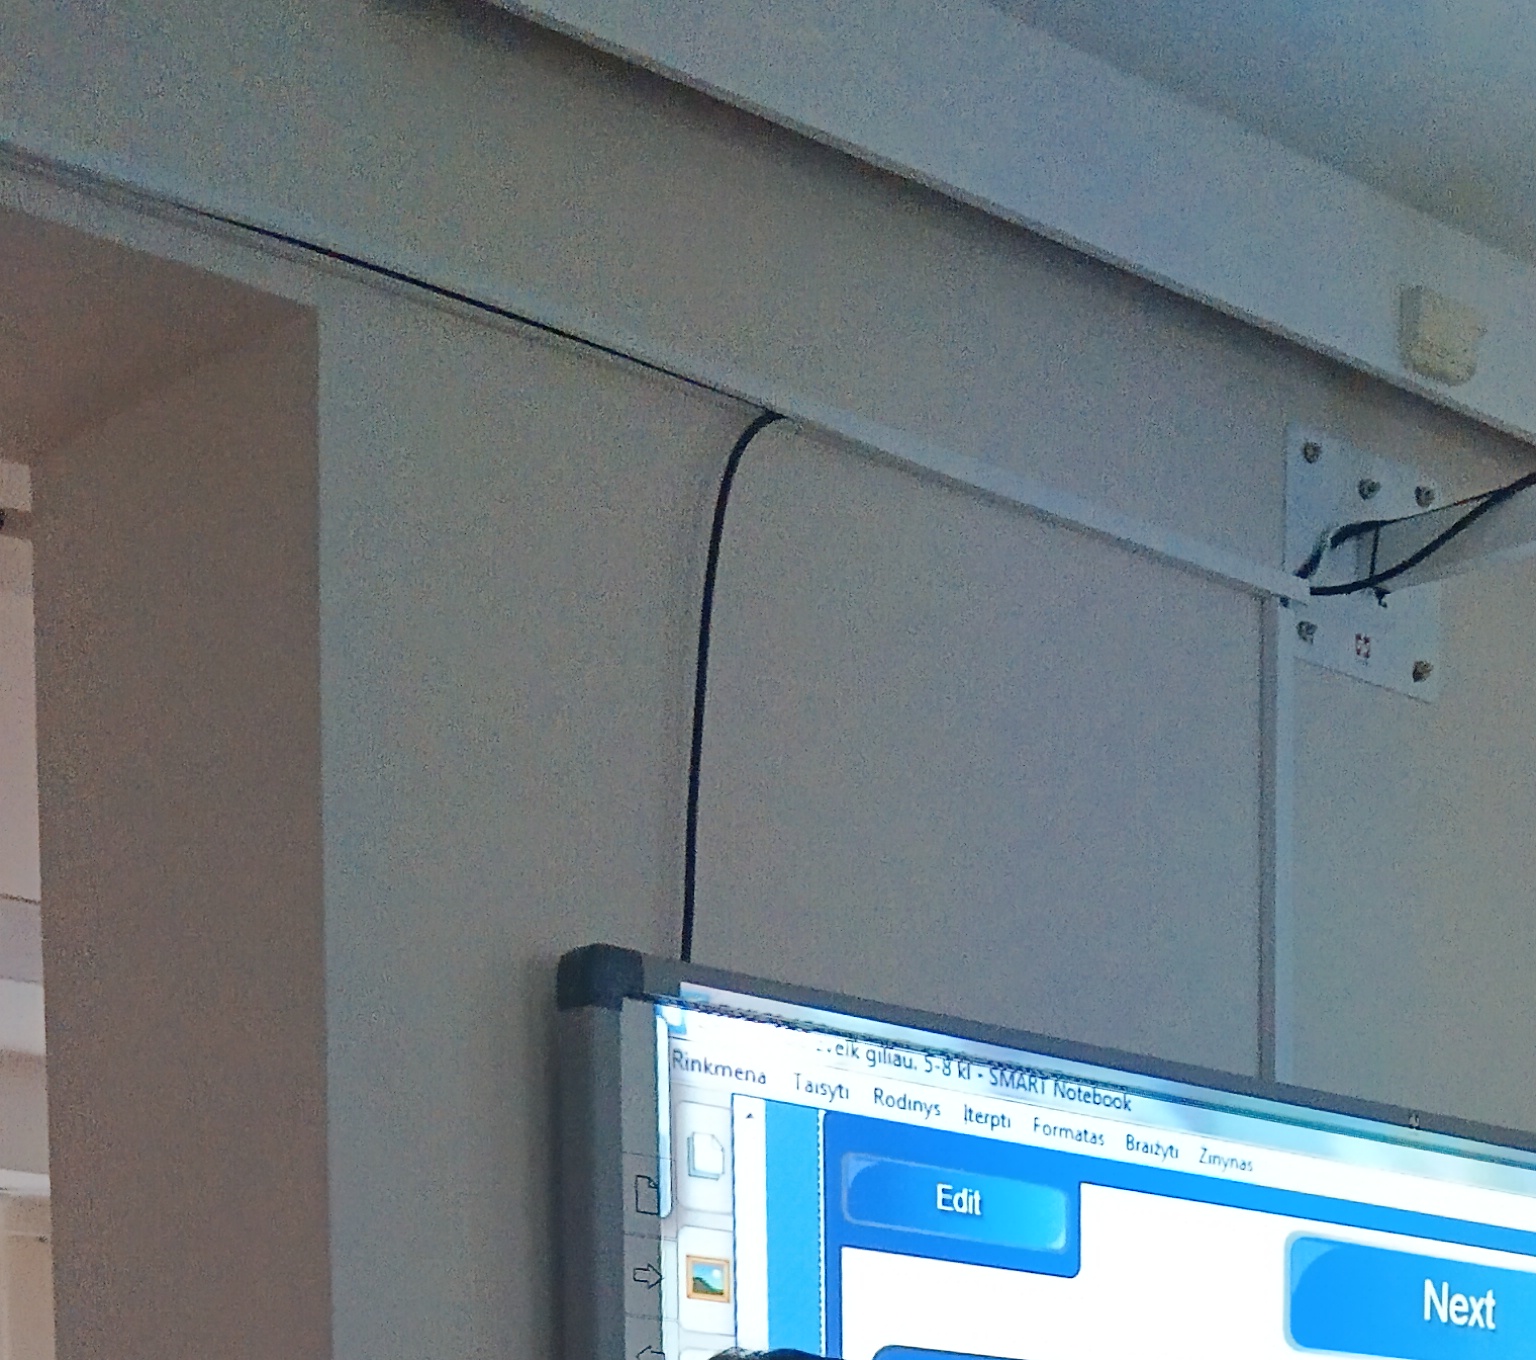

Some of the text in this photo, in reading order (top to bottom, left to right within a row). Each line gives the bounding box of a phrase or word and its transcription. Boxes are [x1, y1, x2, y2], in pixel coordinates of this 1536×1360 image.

[672, 1048, 767, 1085] Rinkmena
[794, 1072, 849, 1104] Taisyti
[873, 1087, 941, 1119] Rodinys
[1033, 1116, 1105, 1147] Formatas
[988, 1066, 1048, 1095] SMART
[1053, 1079, 1132, 1112] Notebook
[936, 1183, 982, 1216] Edit
[1423, 1278, 1497, 1330] Next
